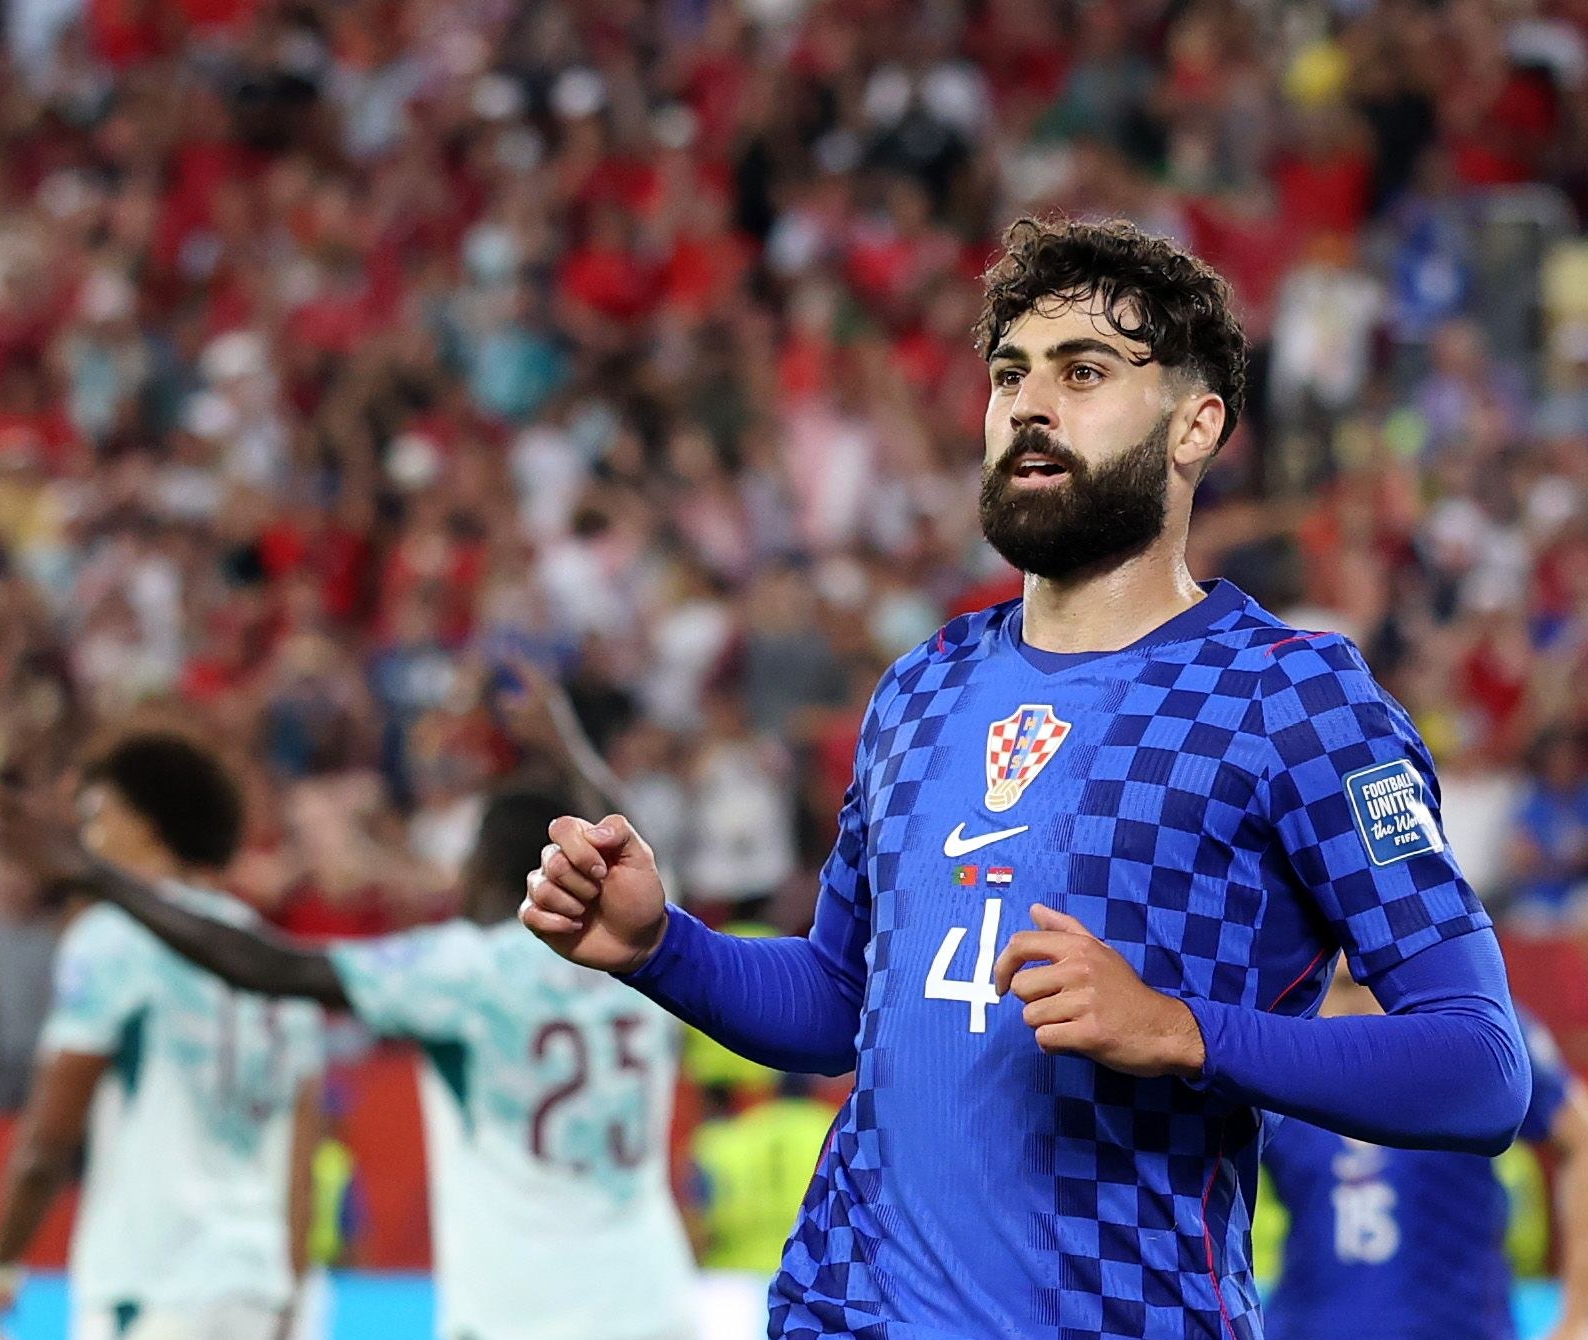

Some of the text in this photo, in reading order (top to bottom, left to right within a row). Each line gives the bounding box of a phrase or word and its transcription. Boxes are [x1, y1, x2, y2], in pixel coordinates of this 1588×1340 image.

[1363, 773, 1414, 800] FOOTBALL
[1371, 820, 1394, 840] the
[1394, 832, 1419, 845] FIFA
[924, 898, 1001, 1033] 4
[529, 1014, 649, 1171] 25
[1332, 1181, 1400, 1265] 15
